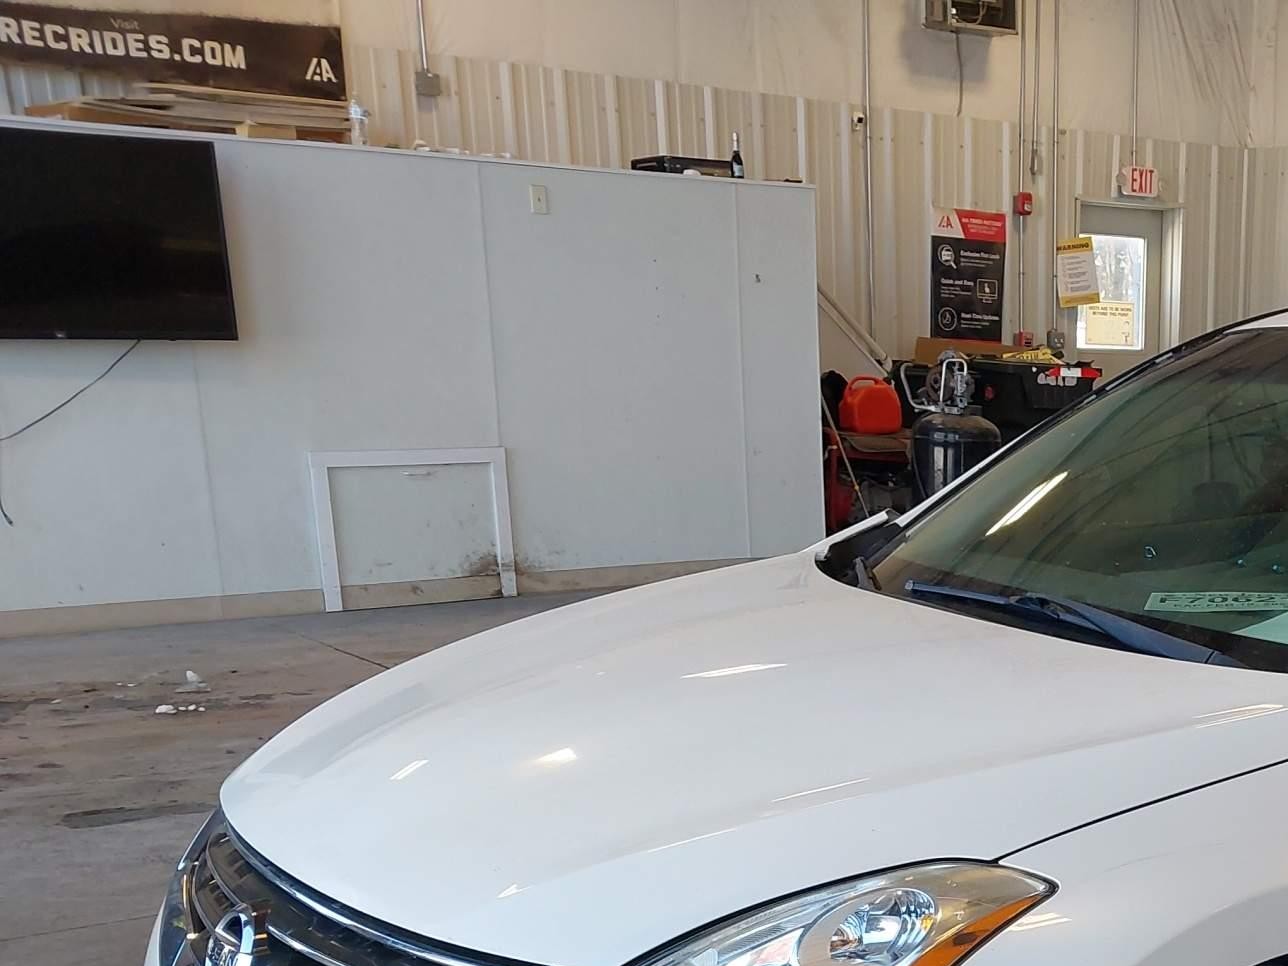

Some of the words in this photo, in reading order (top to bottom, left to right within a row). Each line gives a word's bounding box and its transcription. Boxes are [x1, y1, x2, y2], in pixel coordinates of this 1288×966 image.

[111, 17, 140, 31] Visit
[0, 16, 247, 70] RECRIDES.COM
[1131, 168, 1154, 193] EXIT
